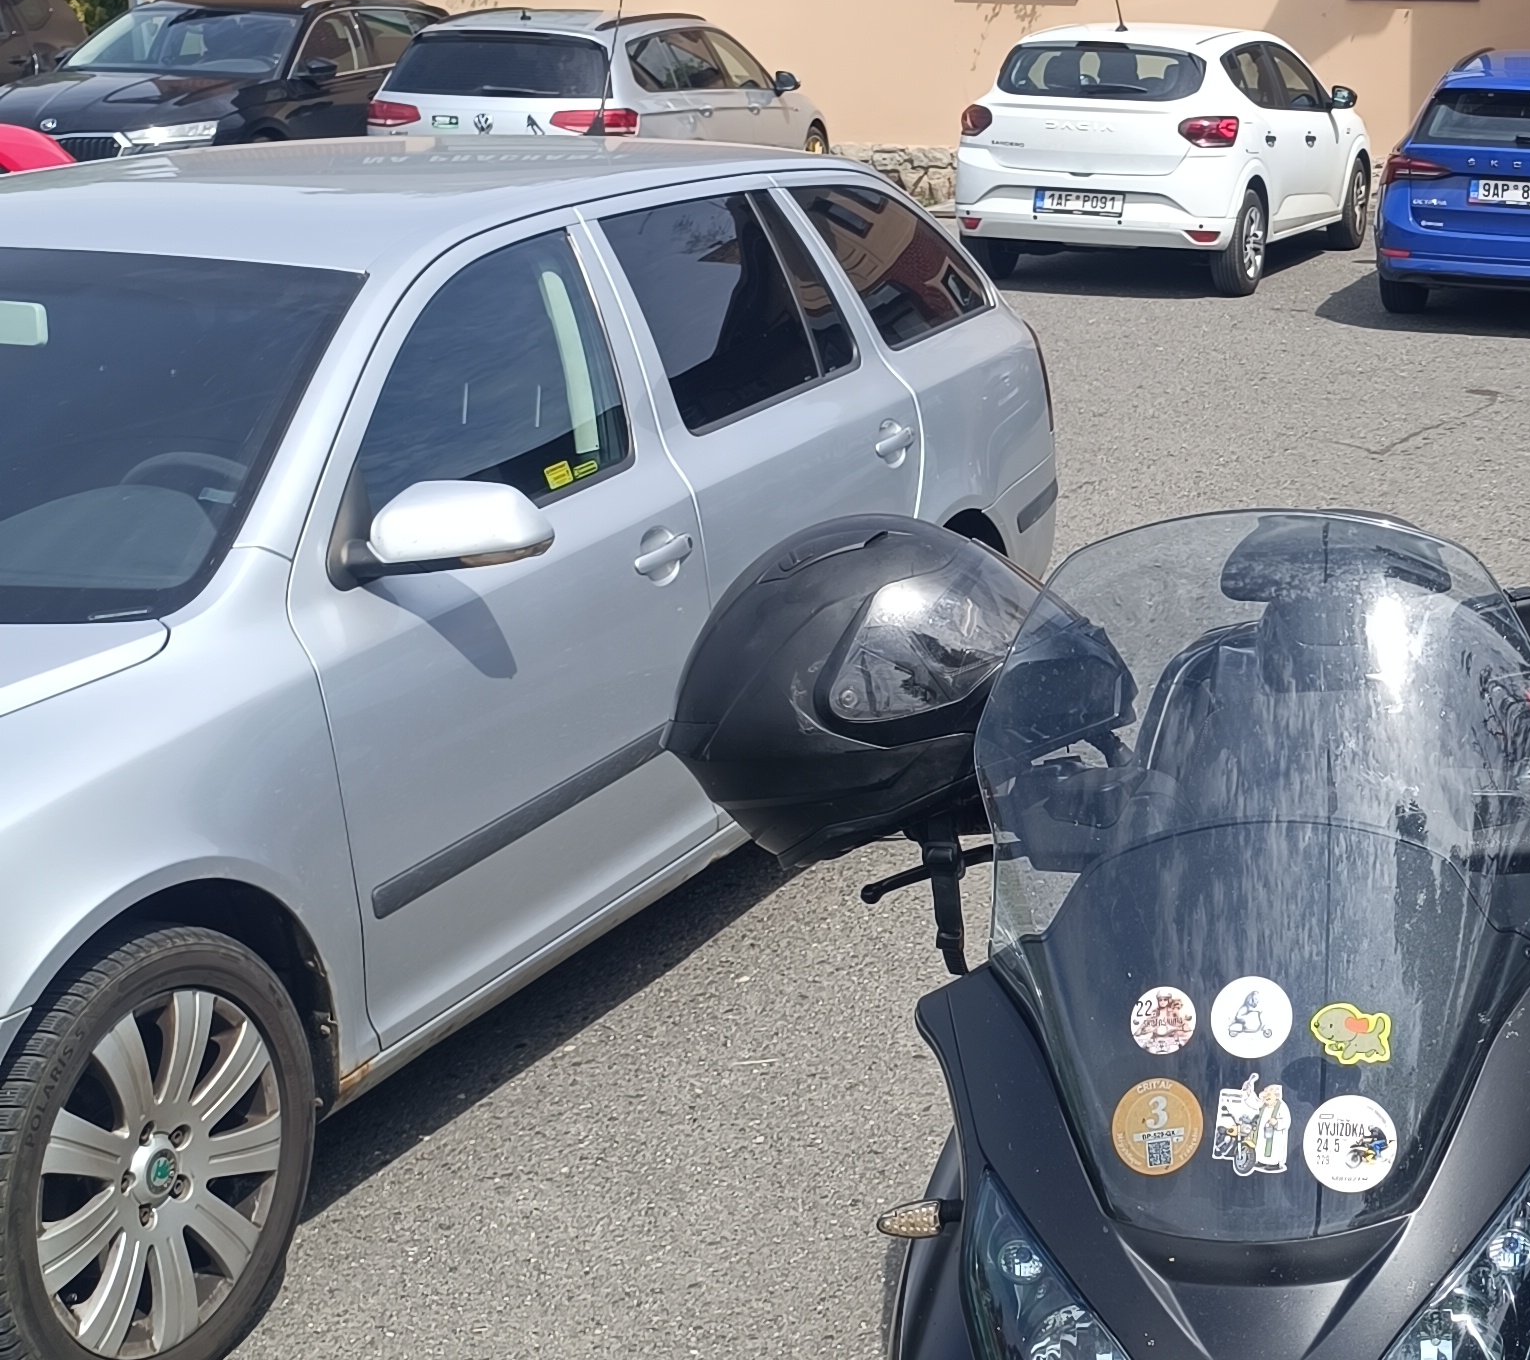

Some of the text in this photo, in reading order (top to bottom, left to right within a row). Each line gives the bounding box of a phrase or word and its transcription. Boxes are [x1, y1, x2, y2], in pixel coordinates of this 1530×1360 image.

[1044, 119, 1115, 133] DACIA
[1482, 182, 1511, 199] 9AP
[1048, 193, 1116, 211] 1AF P091
[25, 1044, 75, 1149] POLARIS
[1146, 1095, 1168, 1130] 3
